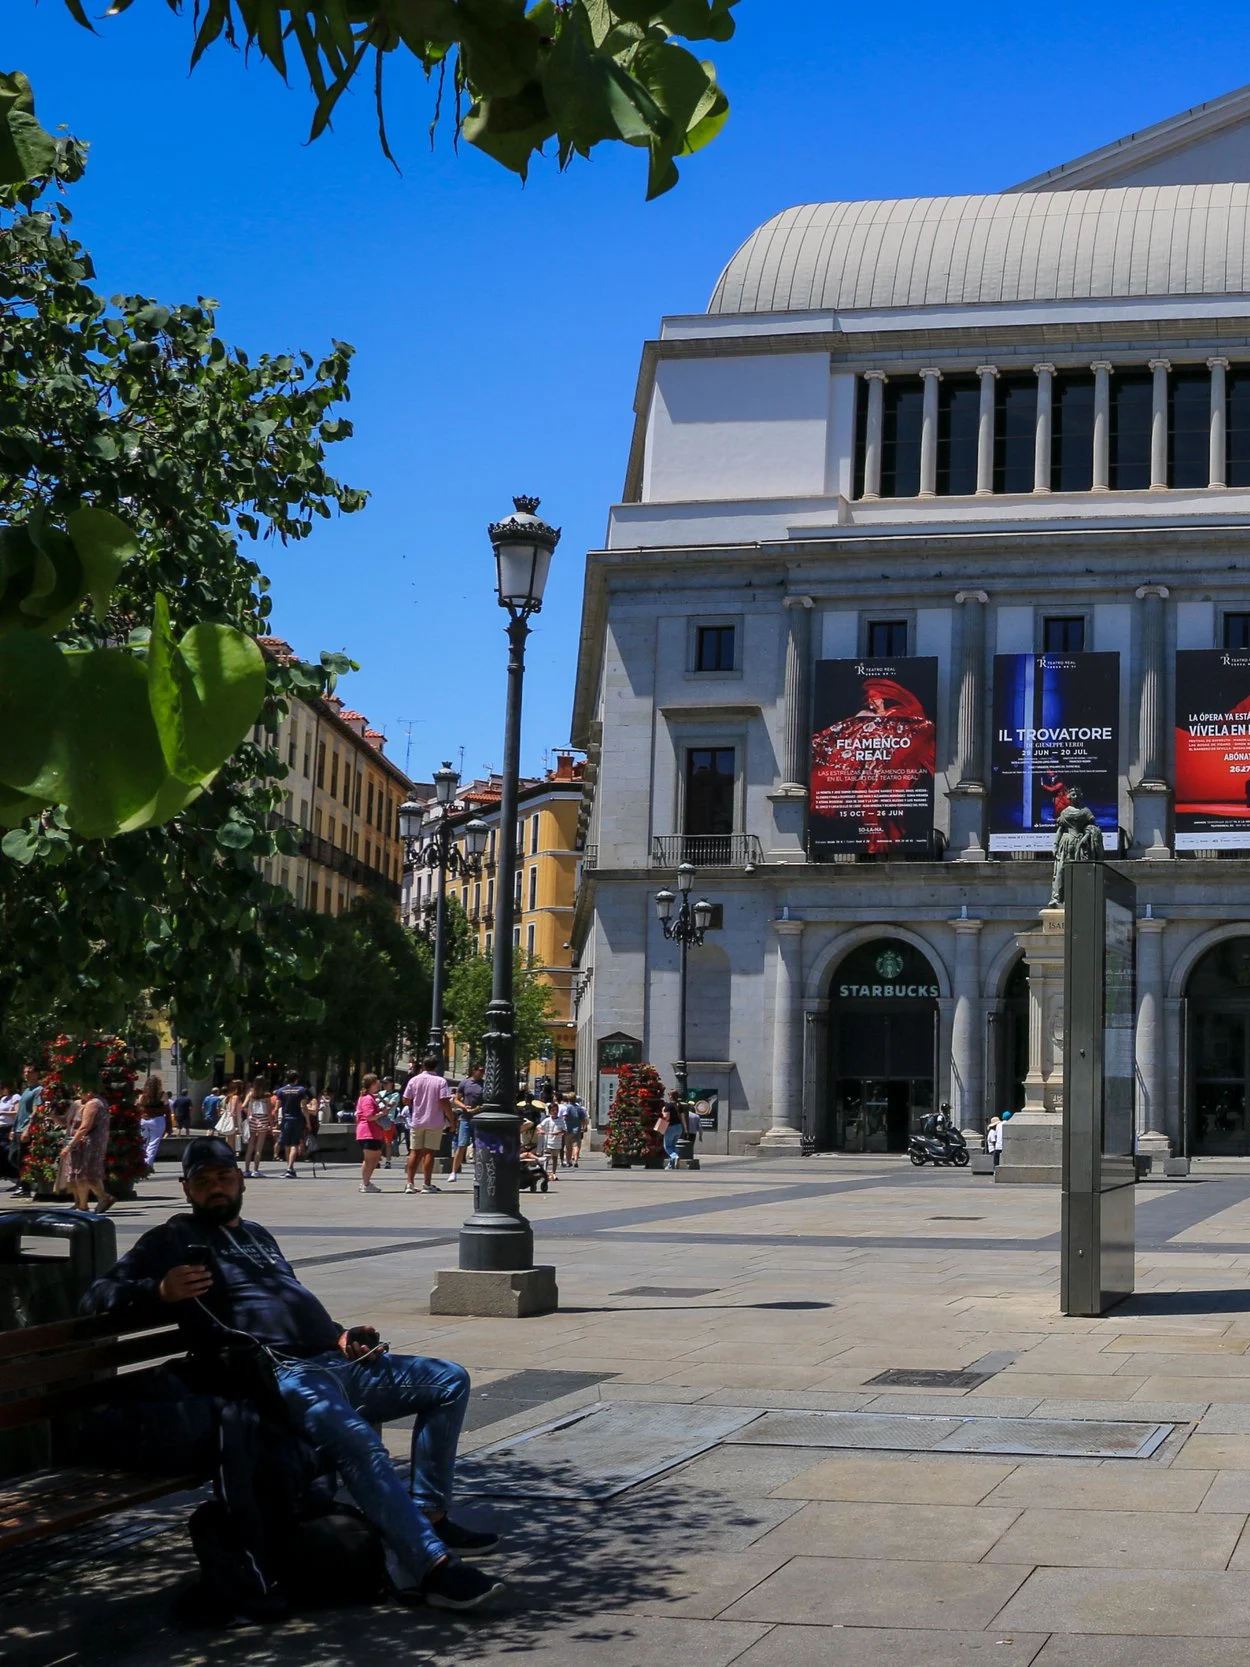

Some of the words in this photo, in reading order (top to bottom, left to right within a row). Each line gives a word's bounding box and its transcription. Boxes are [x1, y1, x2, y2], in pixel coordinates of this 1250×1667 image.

[1199, 712, 1223, 721] ÓPERA
[999, 729, 1013, 741] IL
[1016, 727, 1112, 741] TROVATORE
[1189, 723, 1229, 737] VÍVELA
[1231, 724, 1246, 736] EN
[836, 737, 911, 749] FLAMENCO
[855, 750, 892, 761] REAL
[840, 985, 939, 997] STARBUCKS
